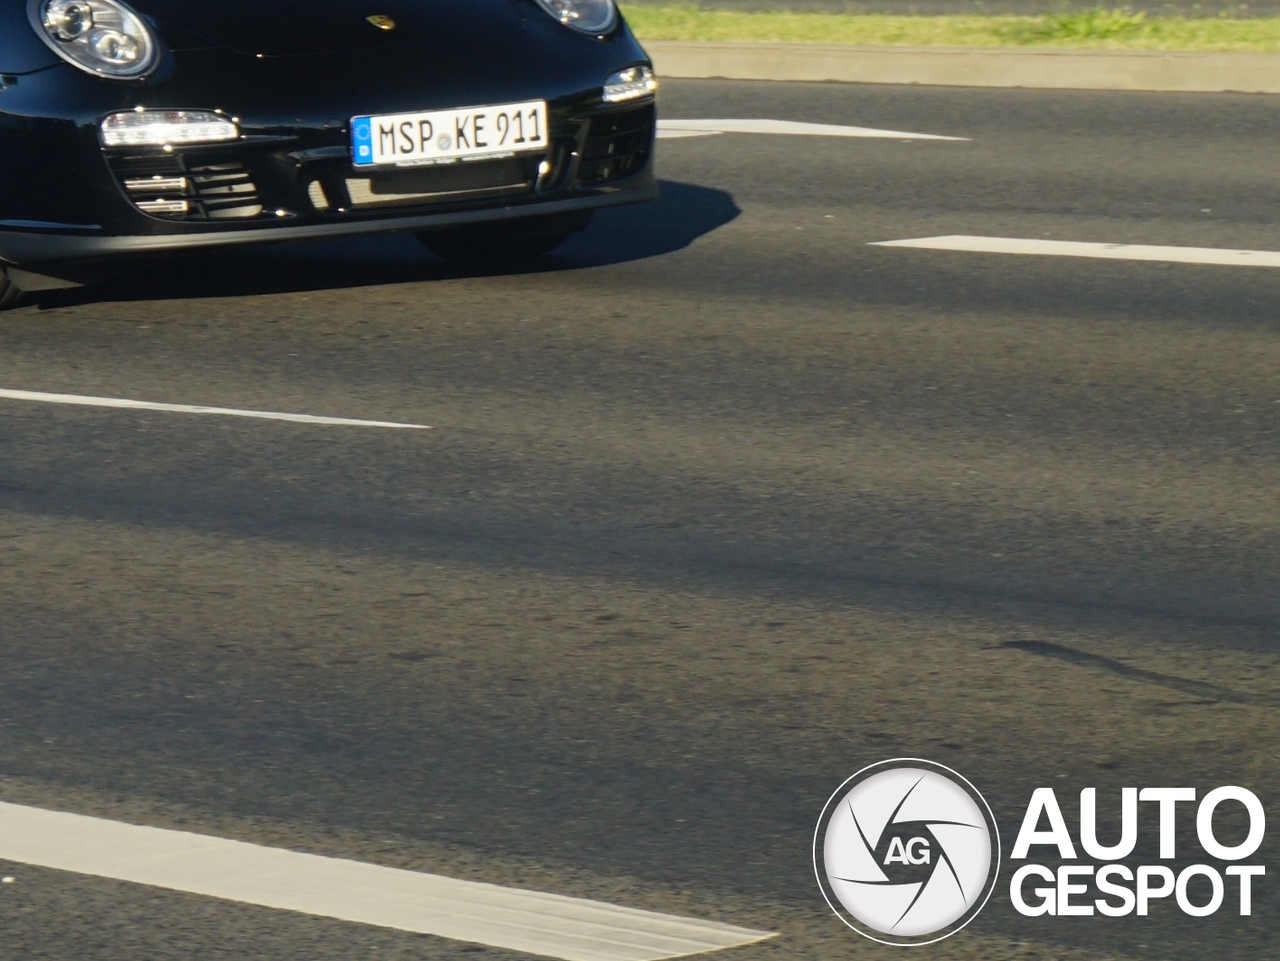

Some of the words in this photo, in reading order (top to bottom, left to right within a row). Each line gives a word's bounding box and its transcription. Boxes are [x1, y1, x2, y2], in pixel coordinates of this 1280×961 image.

[378, 119, 433, 156] MSP
[455, 114, 489, 150] KE
[495, 108, 541, 146] 911
